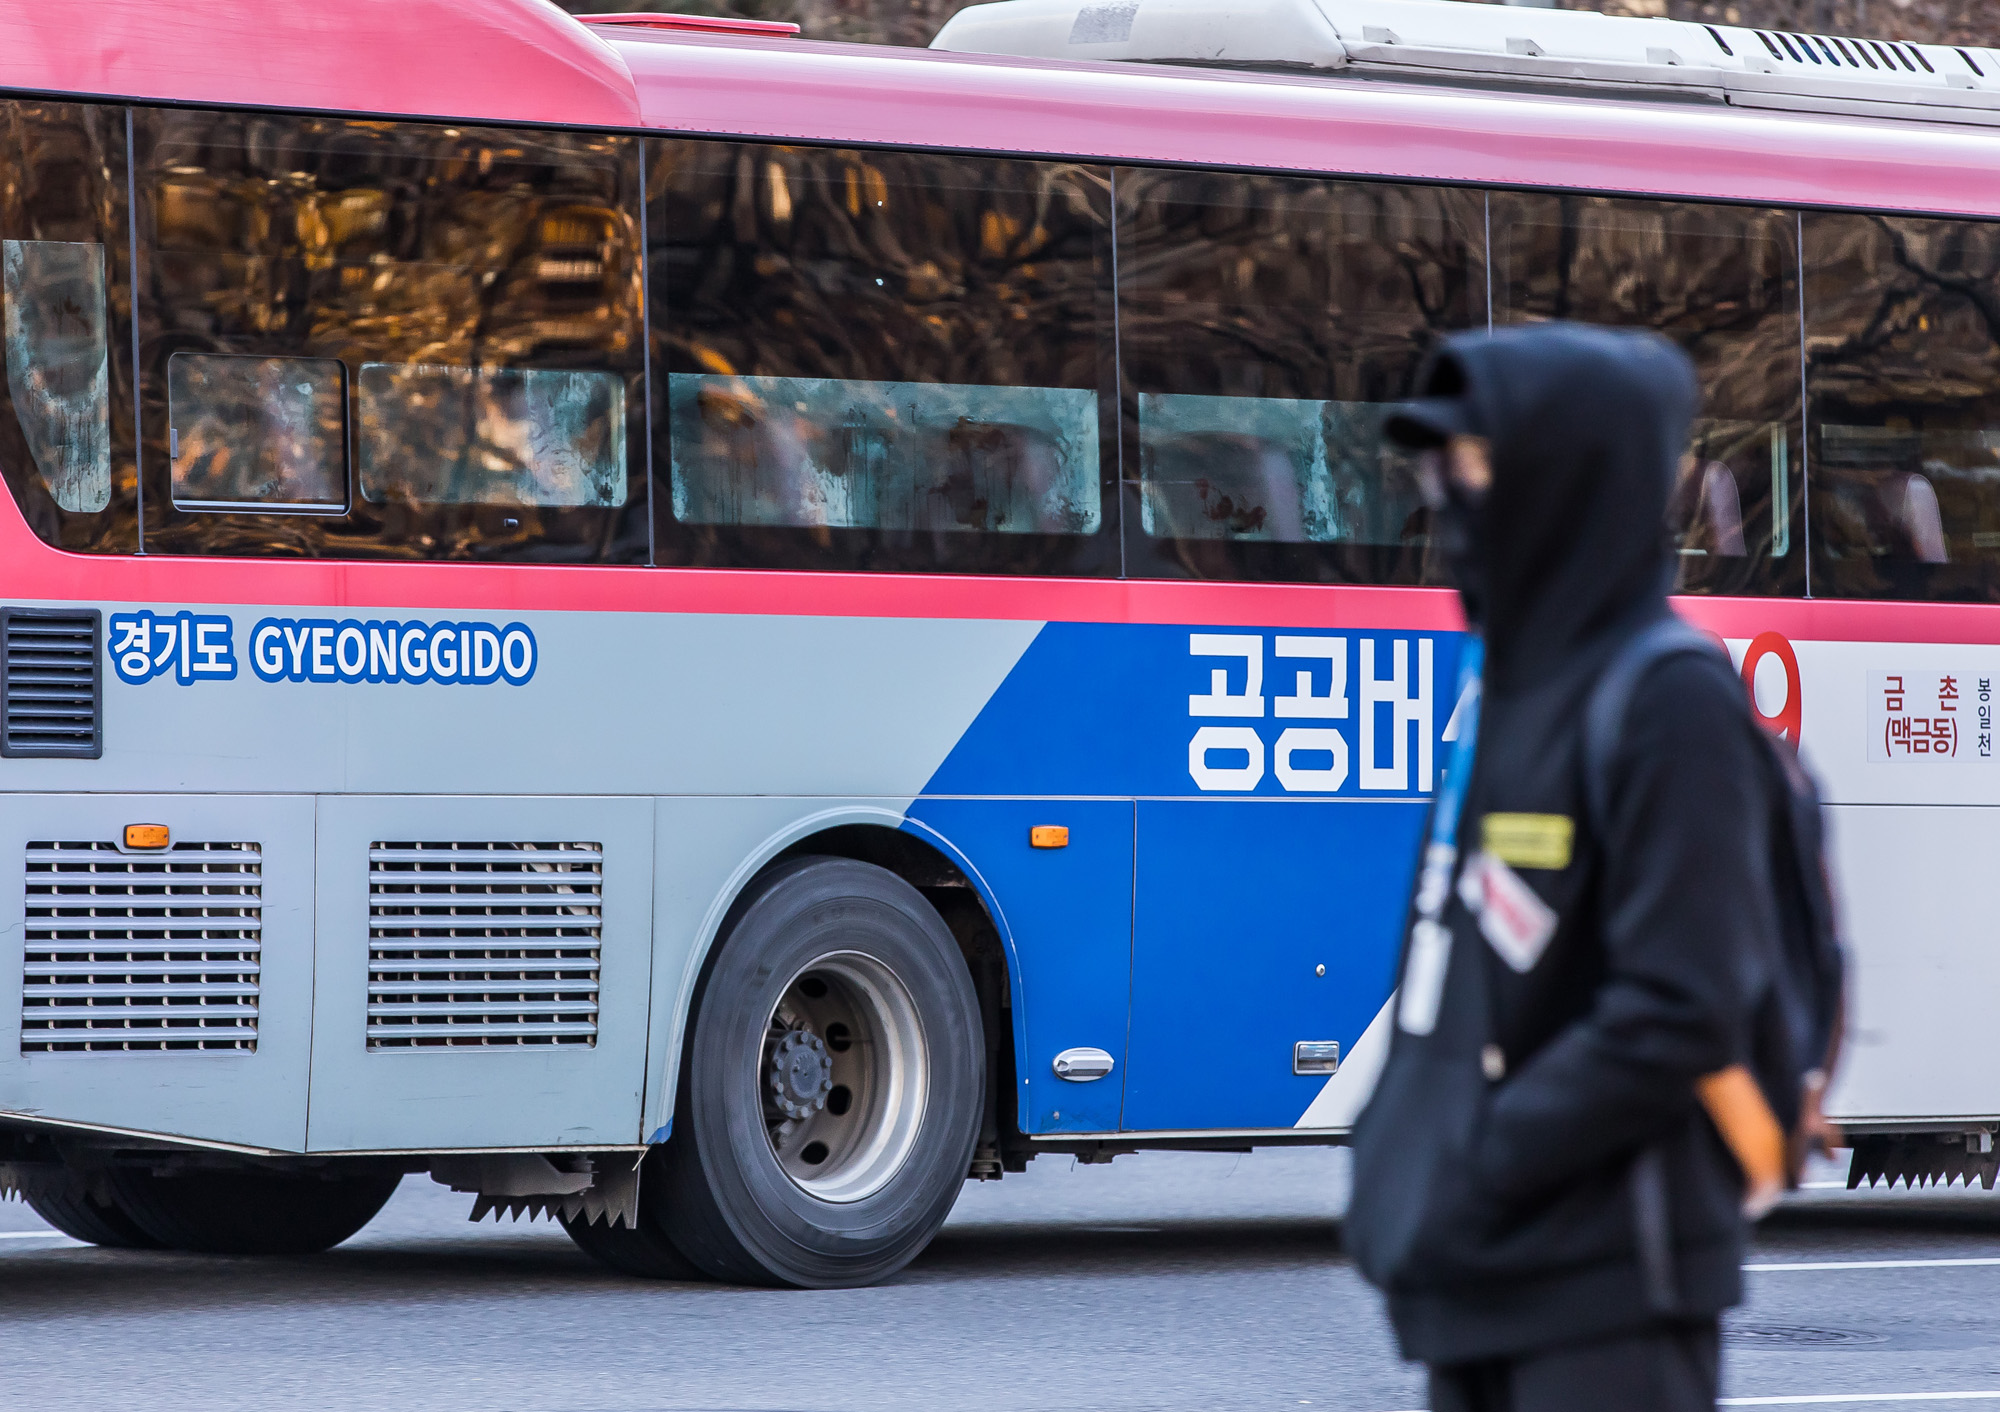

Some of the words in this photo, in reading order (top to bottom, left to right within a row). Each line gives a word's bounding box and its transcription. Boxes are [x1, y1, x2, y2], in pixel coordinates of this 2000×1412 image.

[114, 618, 232, 677] 경기도
[255, 626, 532, 678] GYEONGGIDO
[1885, 716, 1958, 758] (맥금동)
[1977, 678, 1991, 757] 봉일천
